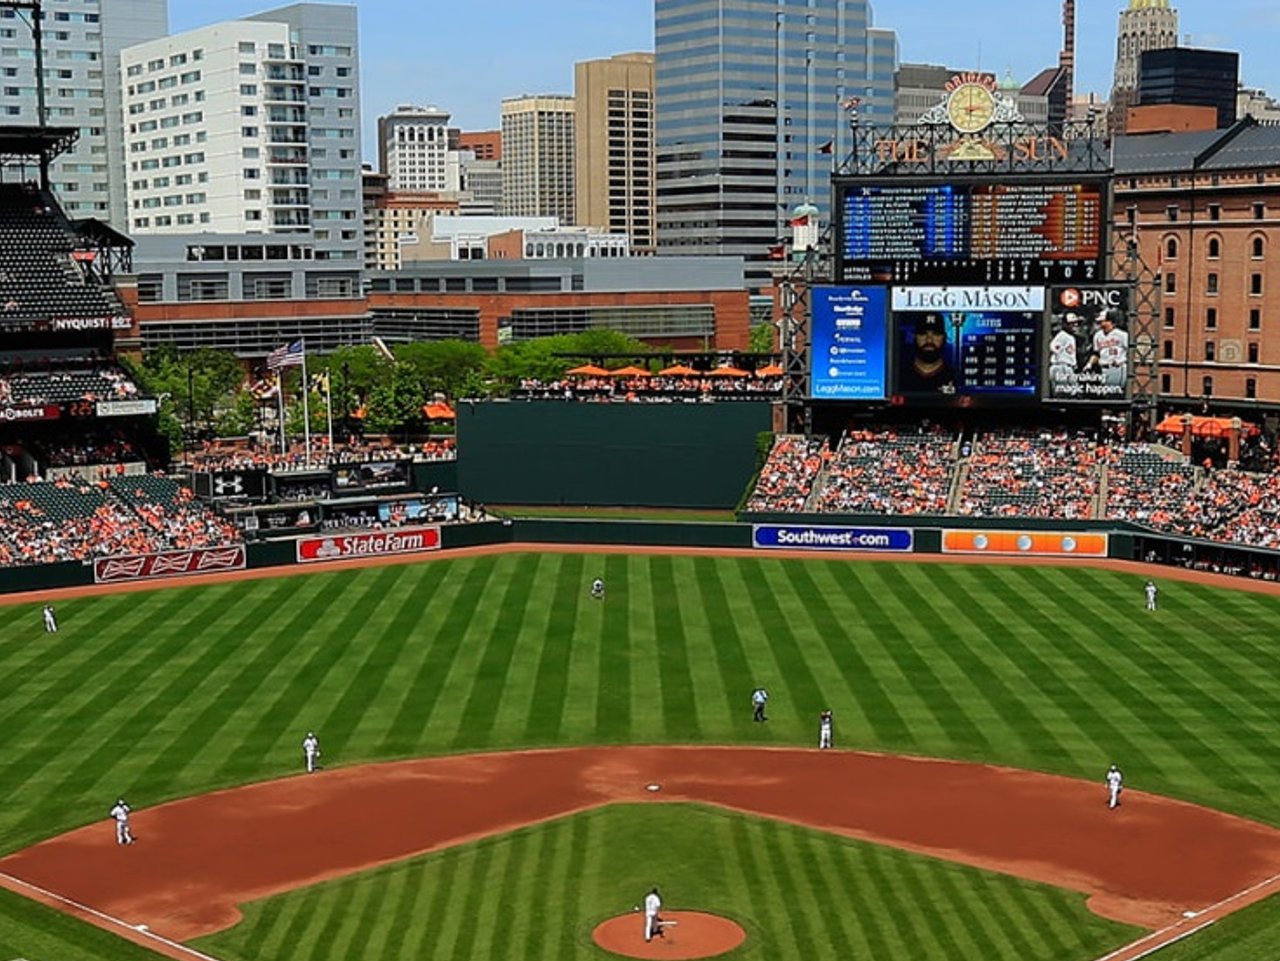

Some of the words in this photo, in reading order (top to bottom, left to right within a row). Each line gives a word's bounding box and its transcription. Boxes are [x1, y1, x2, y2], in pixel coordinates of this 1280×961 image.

[945, 72, 998, 92] ORIOLES
[1014, 136, 1068, 161] SUN
[1043, 267, 1049, 278] 1
[1064, 266, 1072, 279] 0
[1086, 266, 1094, 279] 2
[906, 290, 956, 307] LEGG
[962, 290, 1030, 307] MASON
[1081, 290, 1121, 306] PNC
[55, 318, 106, 330] NYQUIST
[1073, 371, 1107, 384] making
[1055, 384, 1084, 396] magic
